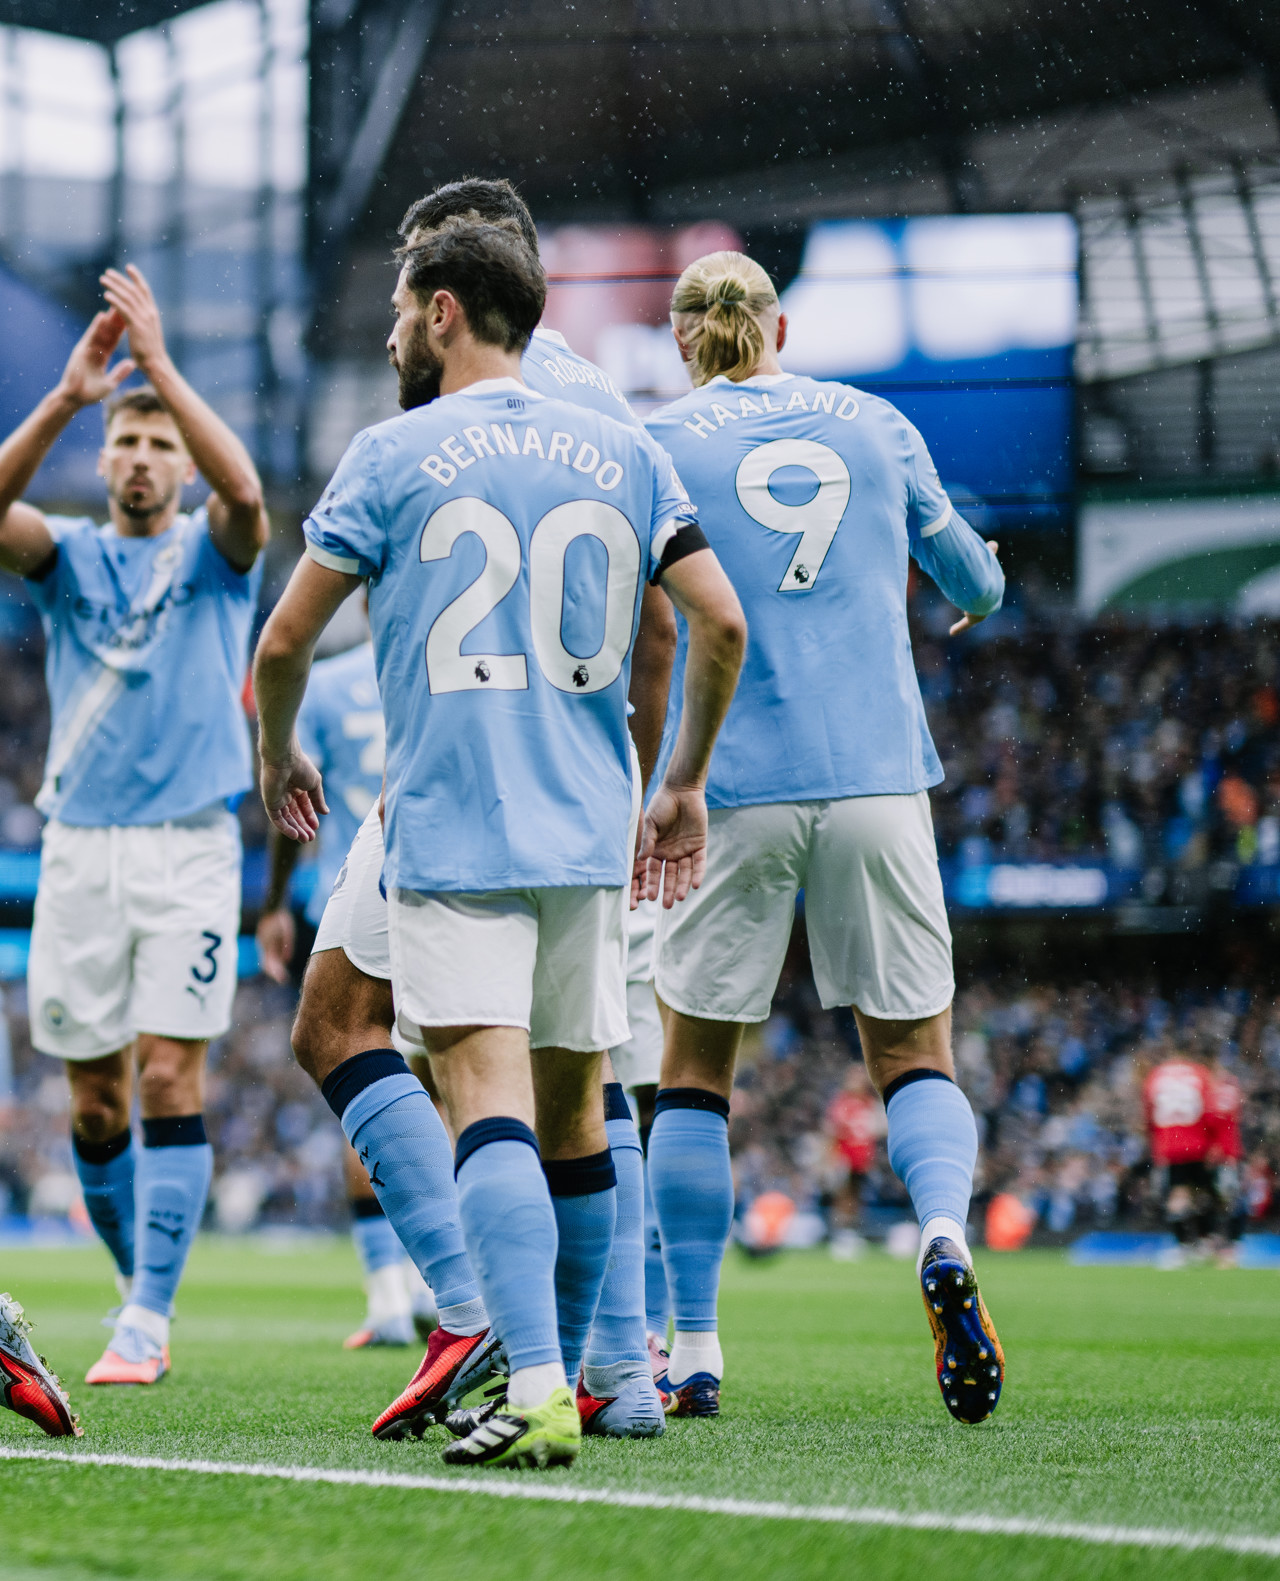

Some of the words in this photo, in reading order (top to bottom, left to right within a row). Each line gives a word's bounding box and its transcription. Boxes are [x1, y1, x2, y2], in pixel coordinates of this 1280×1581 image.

[506, 398, 525, 410] CITY
[683, 391, 860, 439] HAALAND
[419, 422, 624, 491] BERNARDO
[735, 437, 851, 593] 9
[420, 496, 641, 696] 20
[191, 930, 222, 984] 3
